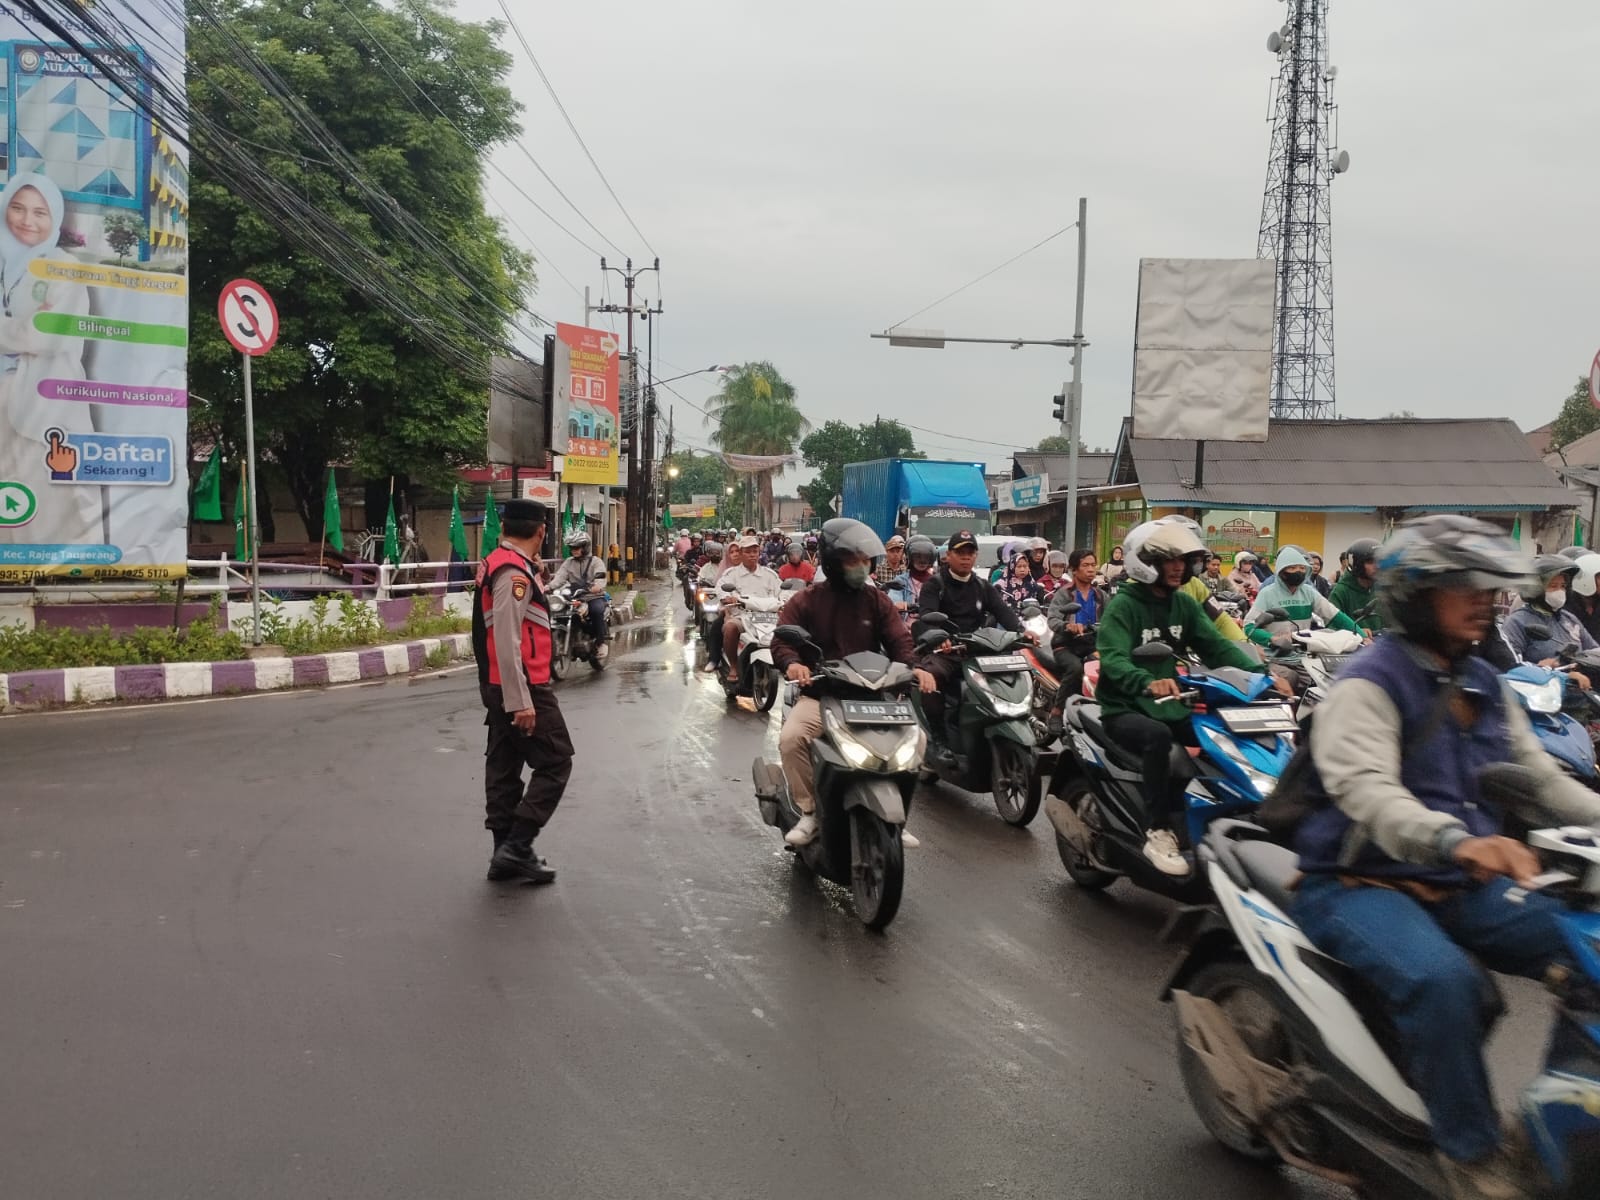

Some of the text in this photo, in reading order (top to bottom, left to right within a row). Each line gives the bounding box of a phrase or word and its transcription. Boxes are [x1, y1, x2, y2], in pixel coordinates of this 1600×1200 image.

[143, 278, 178, 292] Negeri
[78, 320, 130, 337] Bilingual
[56, 384, 174, 403] Kurikulum Nasional
[83, 441, 166, 463] Daftar
[83, 464, 147, 478] Sekarang
[3, 550, 26, 560] Kec.
[29, 550, 58, 562] Rajeg
